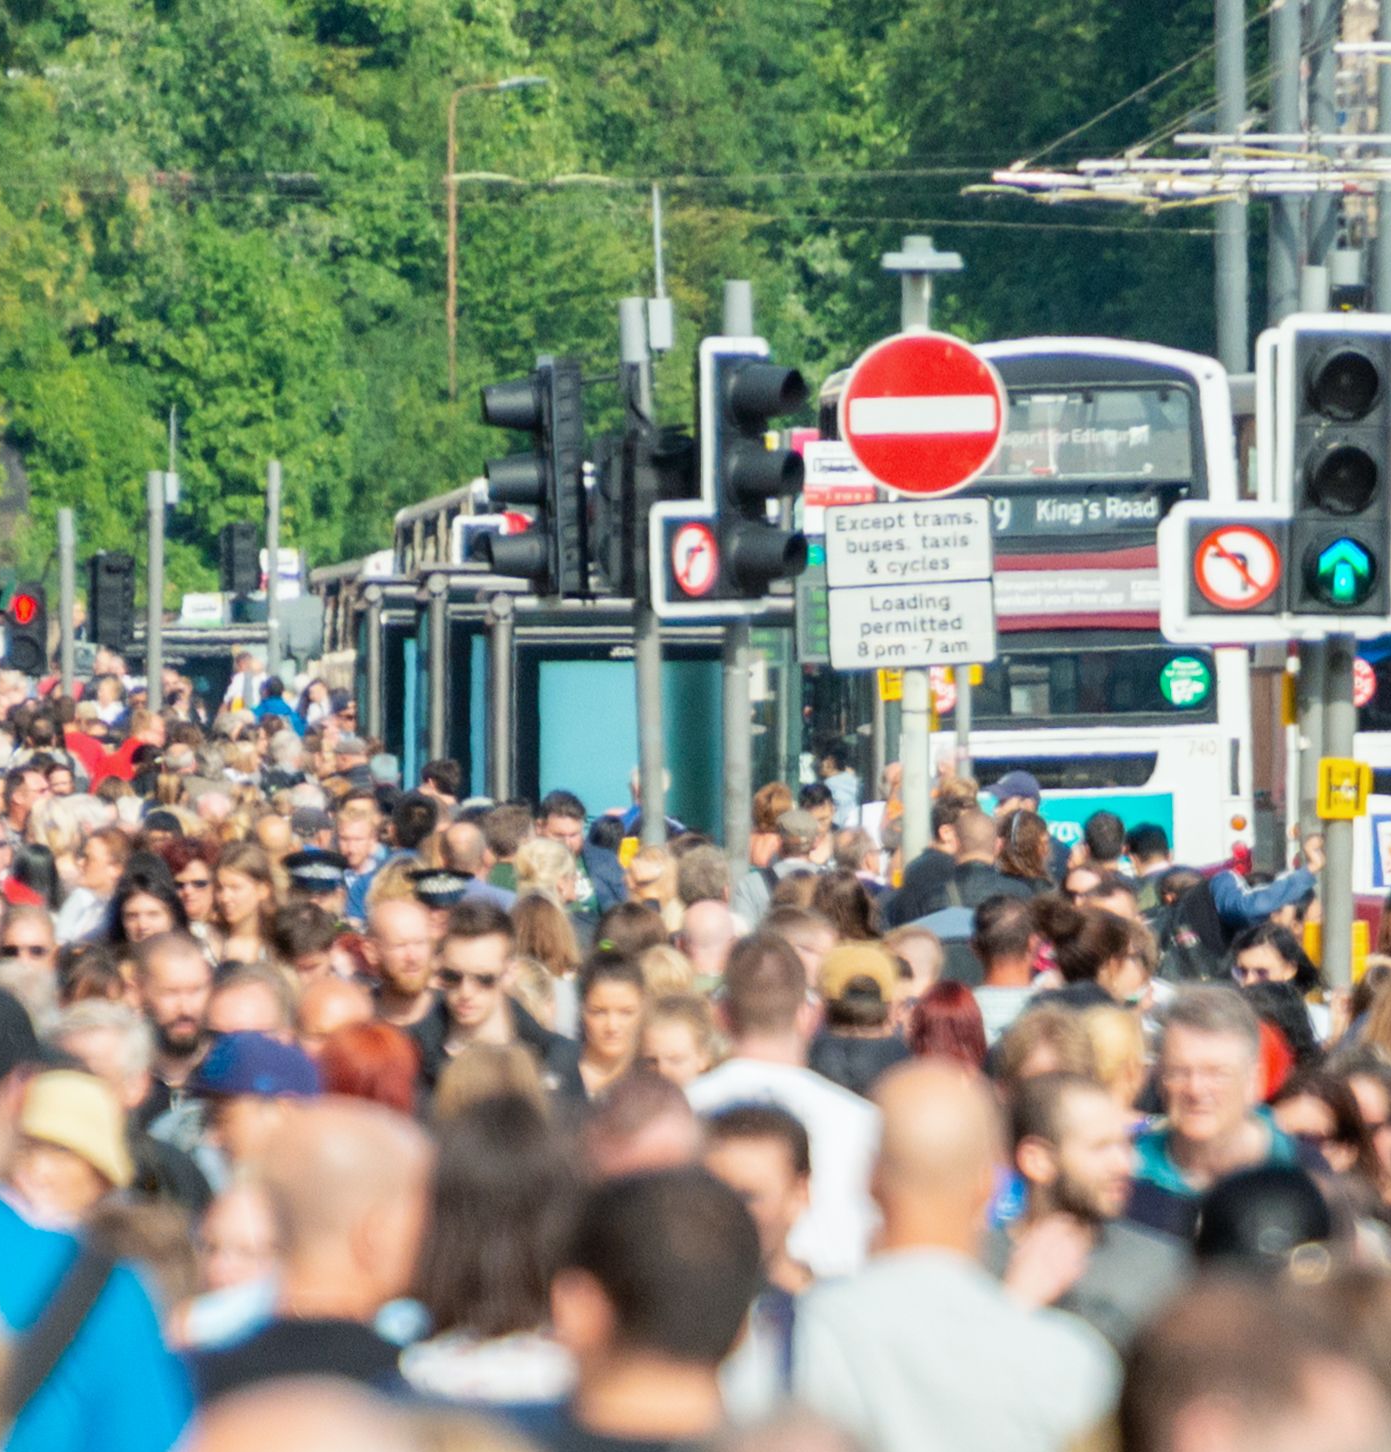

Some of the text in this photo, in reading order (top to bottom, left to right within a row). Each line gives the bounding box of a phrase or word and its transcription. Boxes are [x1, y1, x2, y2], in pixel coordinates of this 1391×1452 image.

[992, 496, 1159, 530] 9 King's Road
[835, 514, 906, 532] Except
[921, 534, 969, 549] taxis
[867, 558, 950, 575] & cycles
[870, 595, 951, 612] Loading
[859, 616, 963, 636] permitted
[858, 642, 869, 657] 8
[875, 645, 905, 659] pm
[924, 639, 934, 653] 7
[939, 641, 969, 653] am
